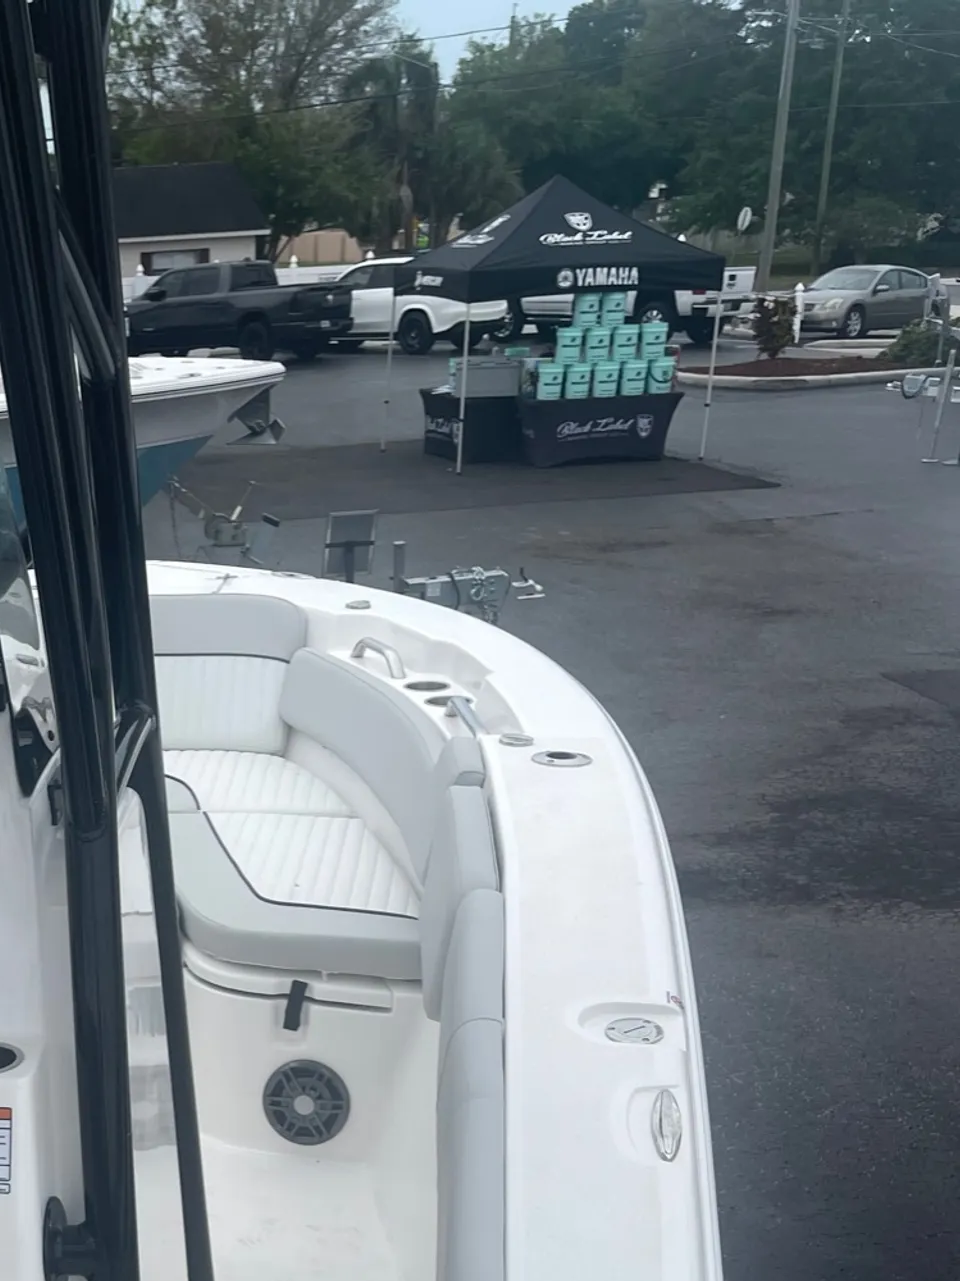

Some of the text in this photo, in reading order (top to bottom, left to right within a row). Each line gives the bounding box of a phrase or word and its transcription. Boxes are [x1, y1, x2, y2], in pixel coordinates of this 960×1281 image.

[539, 232, 583, 245] Black
[585, 230, 633, 241] Label
[575, 267, 639, 287] YAMAHA
[592, 417, 635, 432] Label
